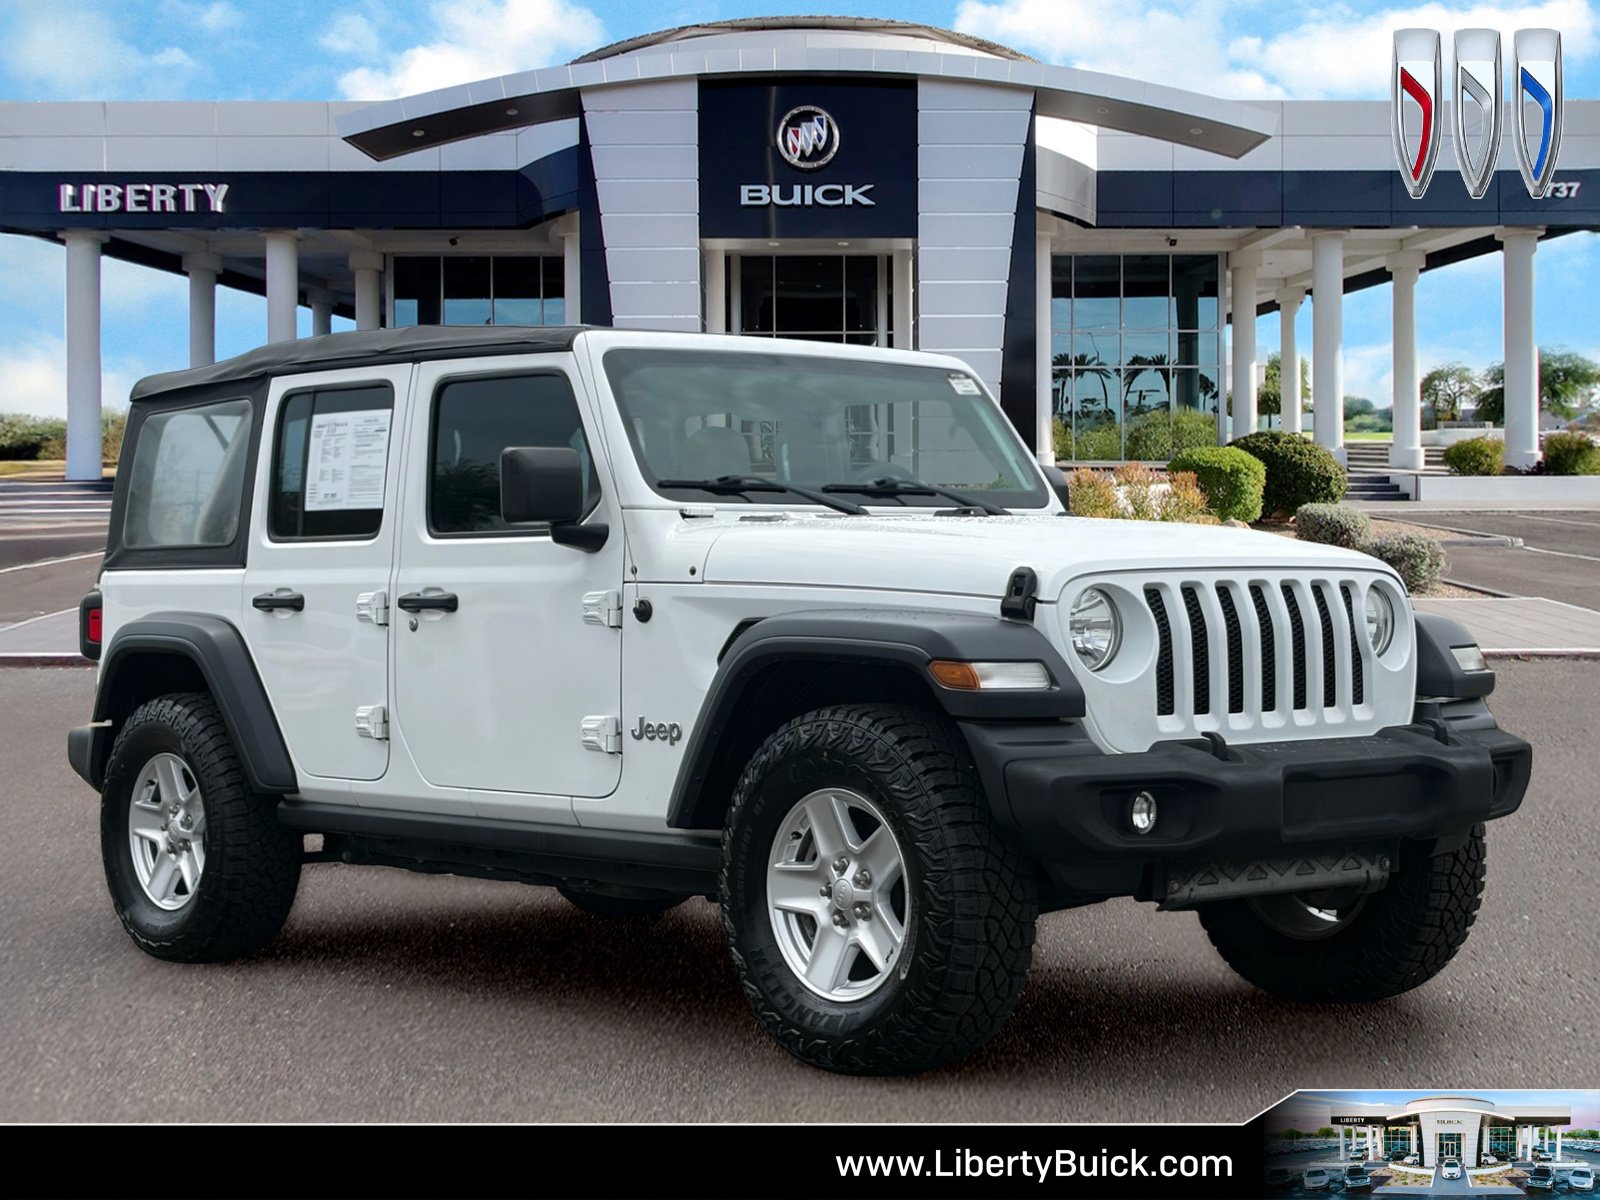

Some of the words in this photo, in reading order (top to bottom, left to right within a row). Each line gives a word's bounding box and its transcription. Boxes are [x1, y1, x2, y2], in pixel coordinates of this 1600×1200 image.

[58, 183, 229, 213] LIBERTY
[740, 184, 876, 207] BUICK
[630, 714, 683, 746] Jeep
